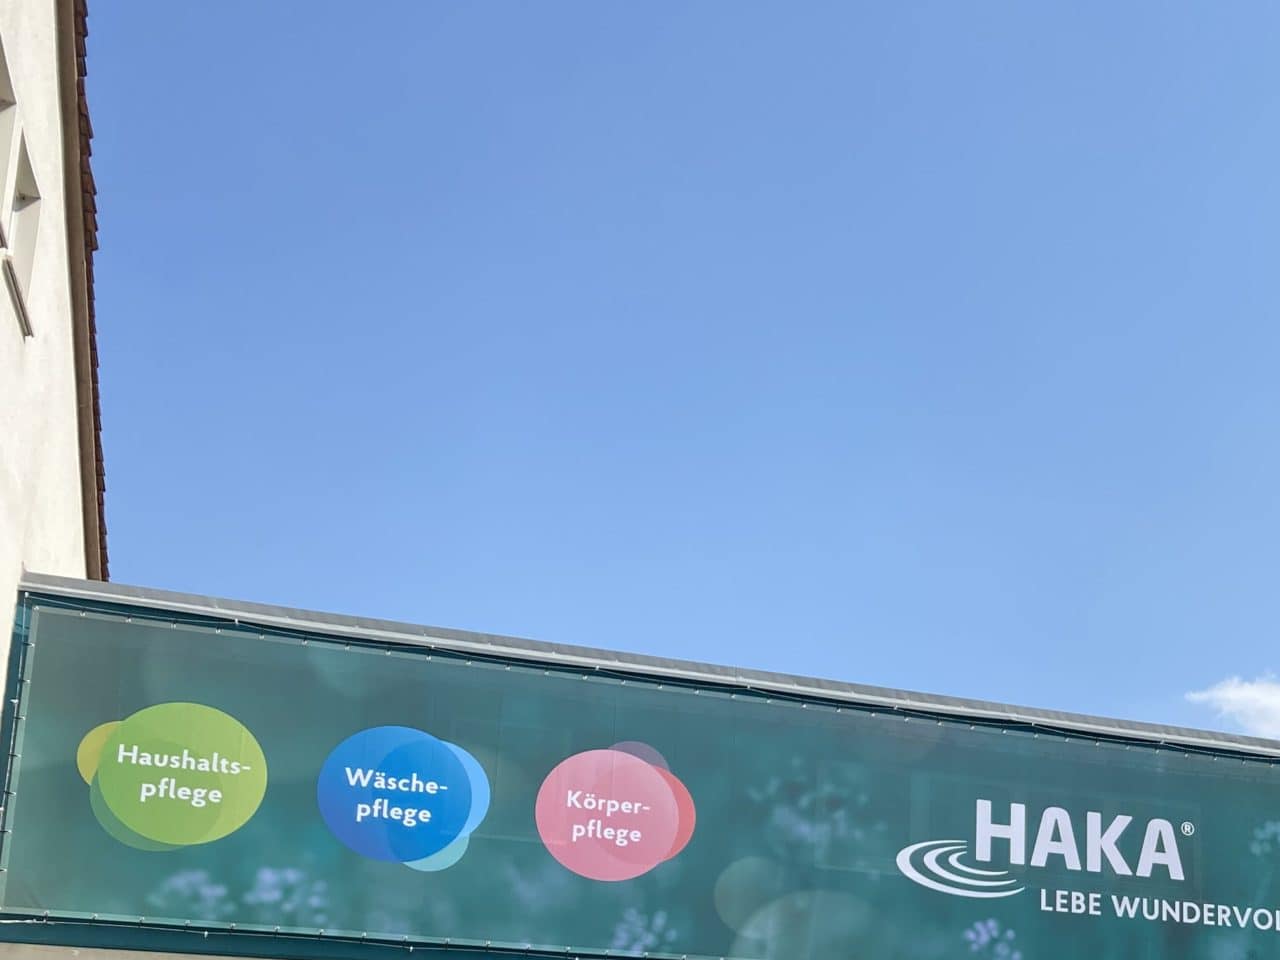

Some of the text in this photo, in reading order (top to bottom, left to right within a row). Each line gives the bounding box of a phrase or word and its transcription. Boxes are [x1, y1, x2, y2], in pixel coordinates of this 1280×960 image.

[117, 743, 252, 775] Haushalts-
[139, 777, 223, 808] pflege
[344, 767, 449, 795] Wäsche-
[355, 798, 432, 827] pflege
[566, 789, 652, 817] Körper-
[572, 819, 642, 847] pflege
[1039, 888, 1102, 916] LEBE
